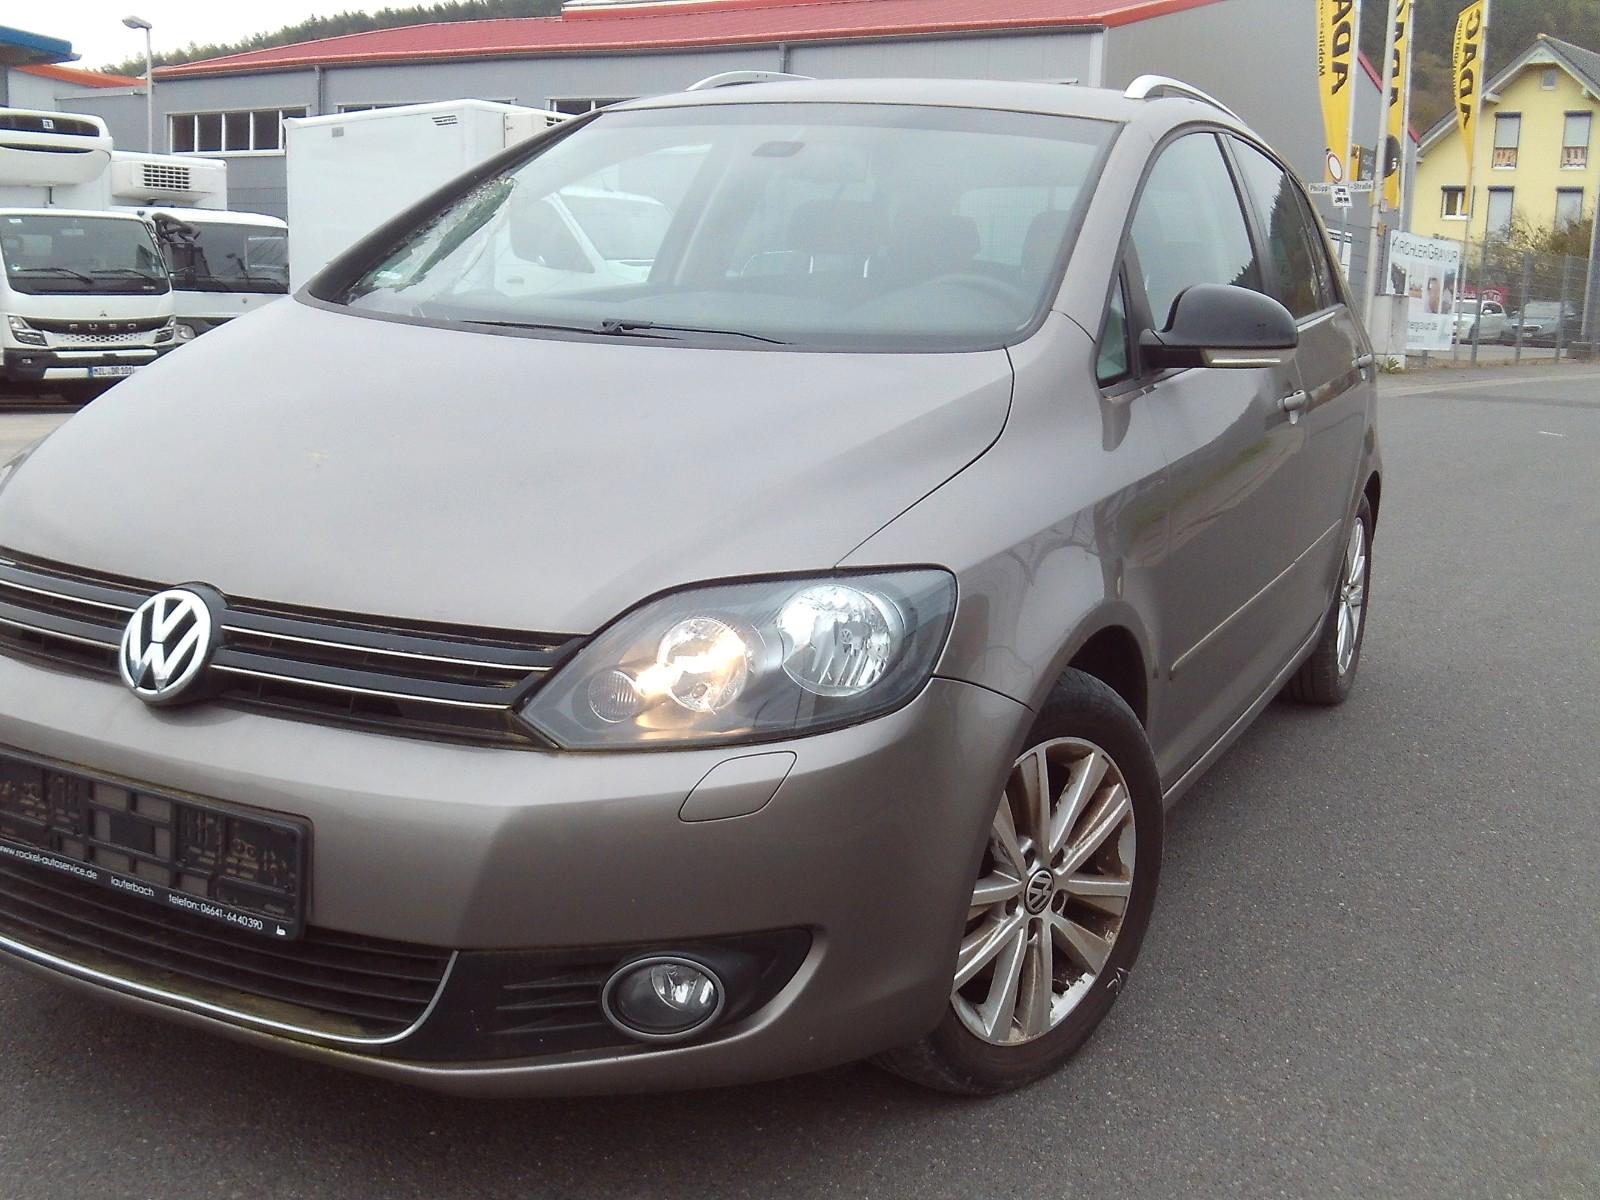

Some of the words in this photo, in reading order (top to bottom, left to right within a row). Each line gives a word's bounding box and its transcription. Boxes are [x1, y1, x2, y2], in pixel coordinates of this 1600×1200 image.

[120, 589, 211, 700] VW
[111, 876, 154, 897] lauterbach
[168, 893, 200, 911] telefon:
[1024, 868, 1055, 914] VW
